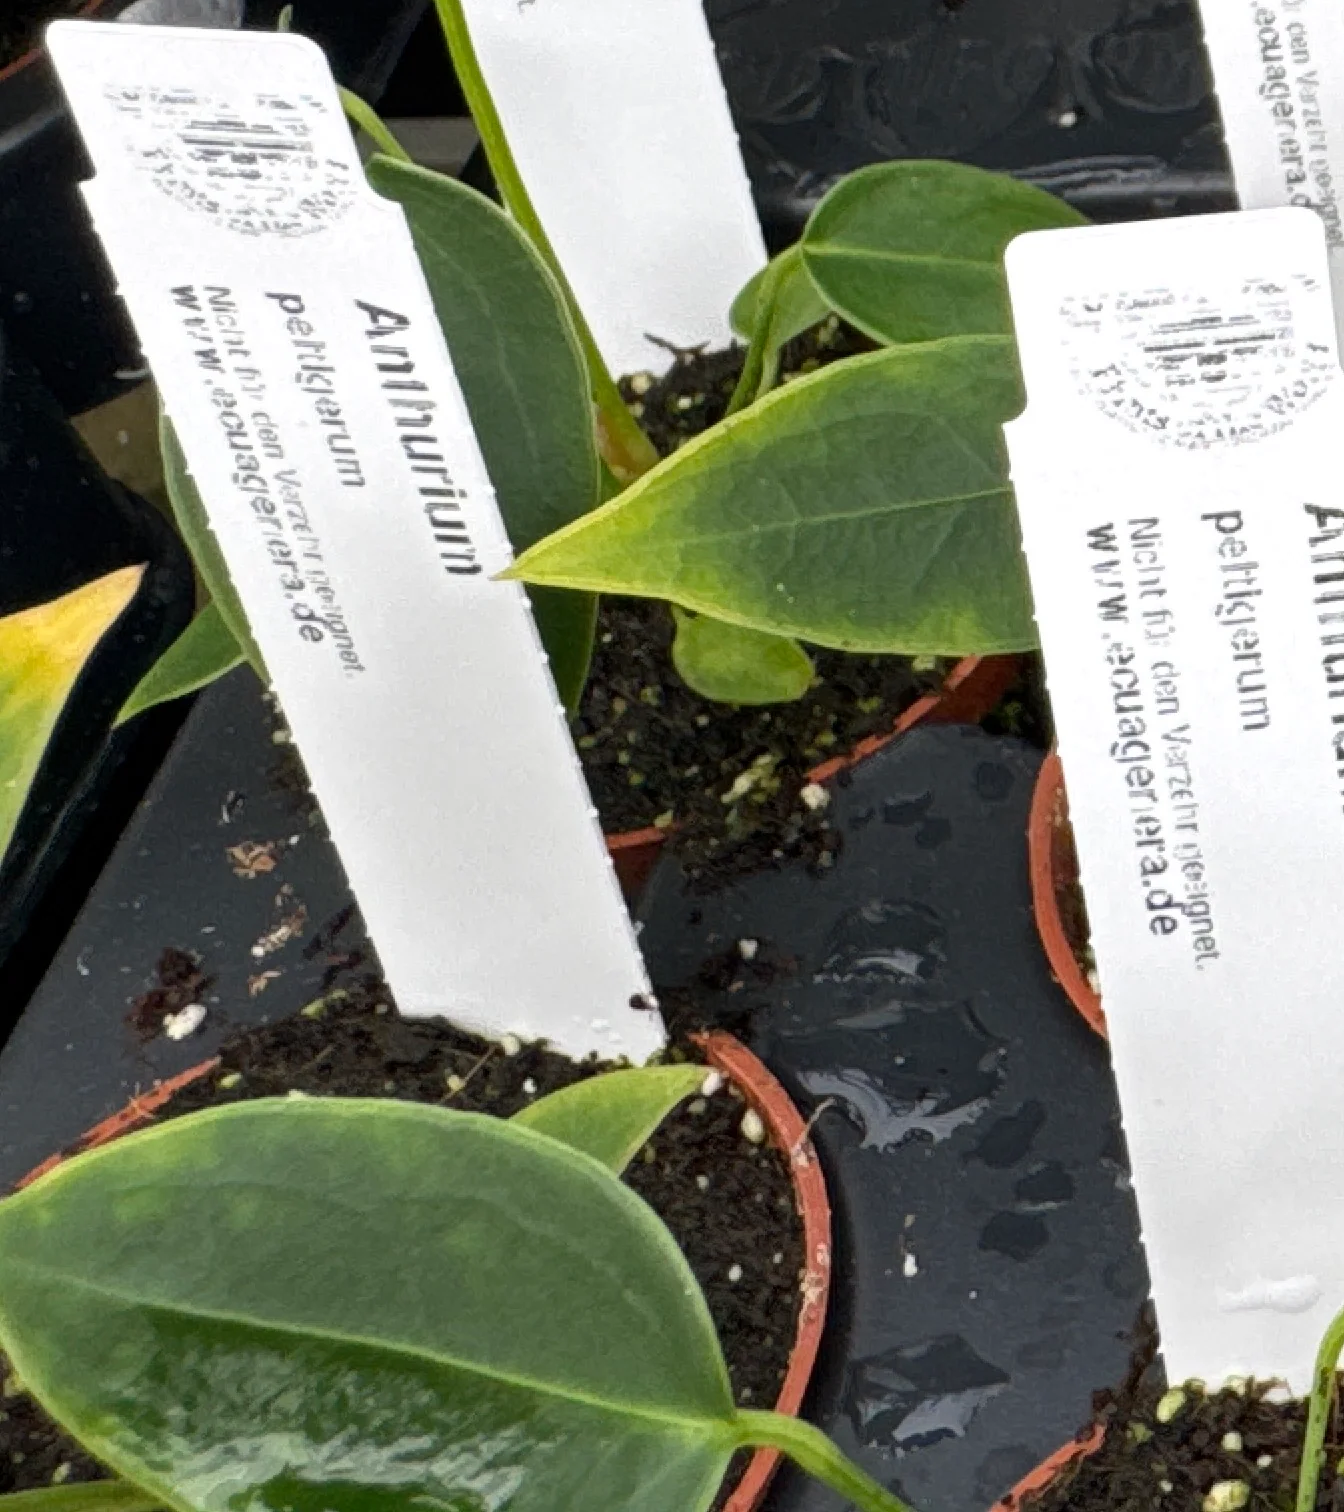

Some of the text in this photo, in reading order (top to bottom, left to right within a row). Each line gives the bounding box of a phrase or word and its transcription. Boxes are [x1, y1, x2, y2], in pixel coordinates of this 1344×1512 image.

[204, 285, 252, 358] Nicht
[264, 290, 366, 488] peltigerum
[168, 284, 329, 644] www.ecuagenera.de
[354, 299, 482, 577] Anthurium
[1126, 516, 1168, 600] Nicht
[1150, 660, 1182, 716] den
[1200, 509, 1271, 732] peltigerum
[1085, 521, 1185, 937] www.ecuagenera.de
